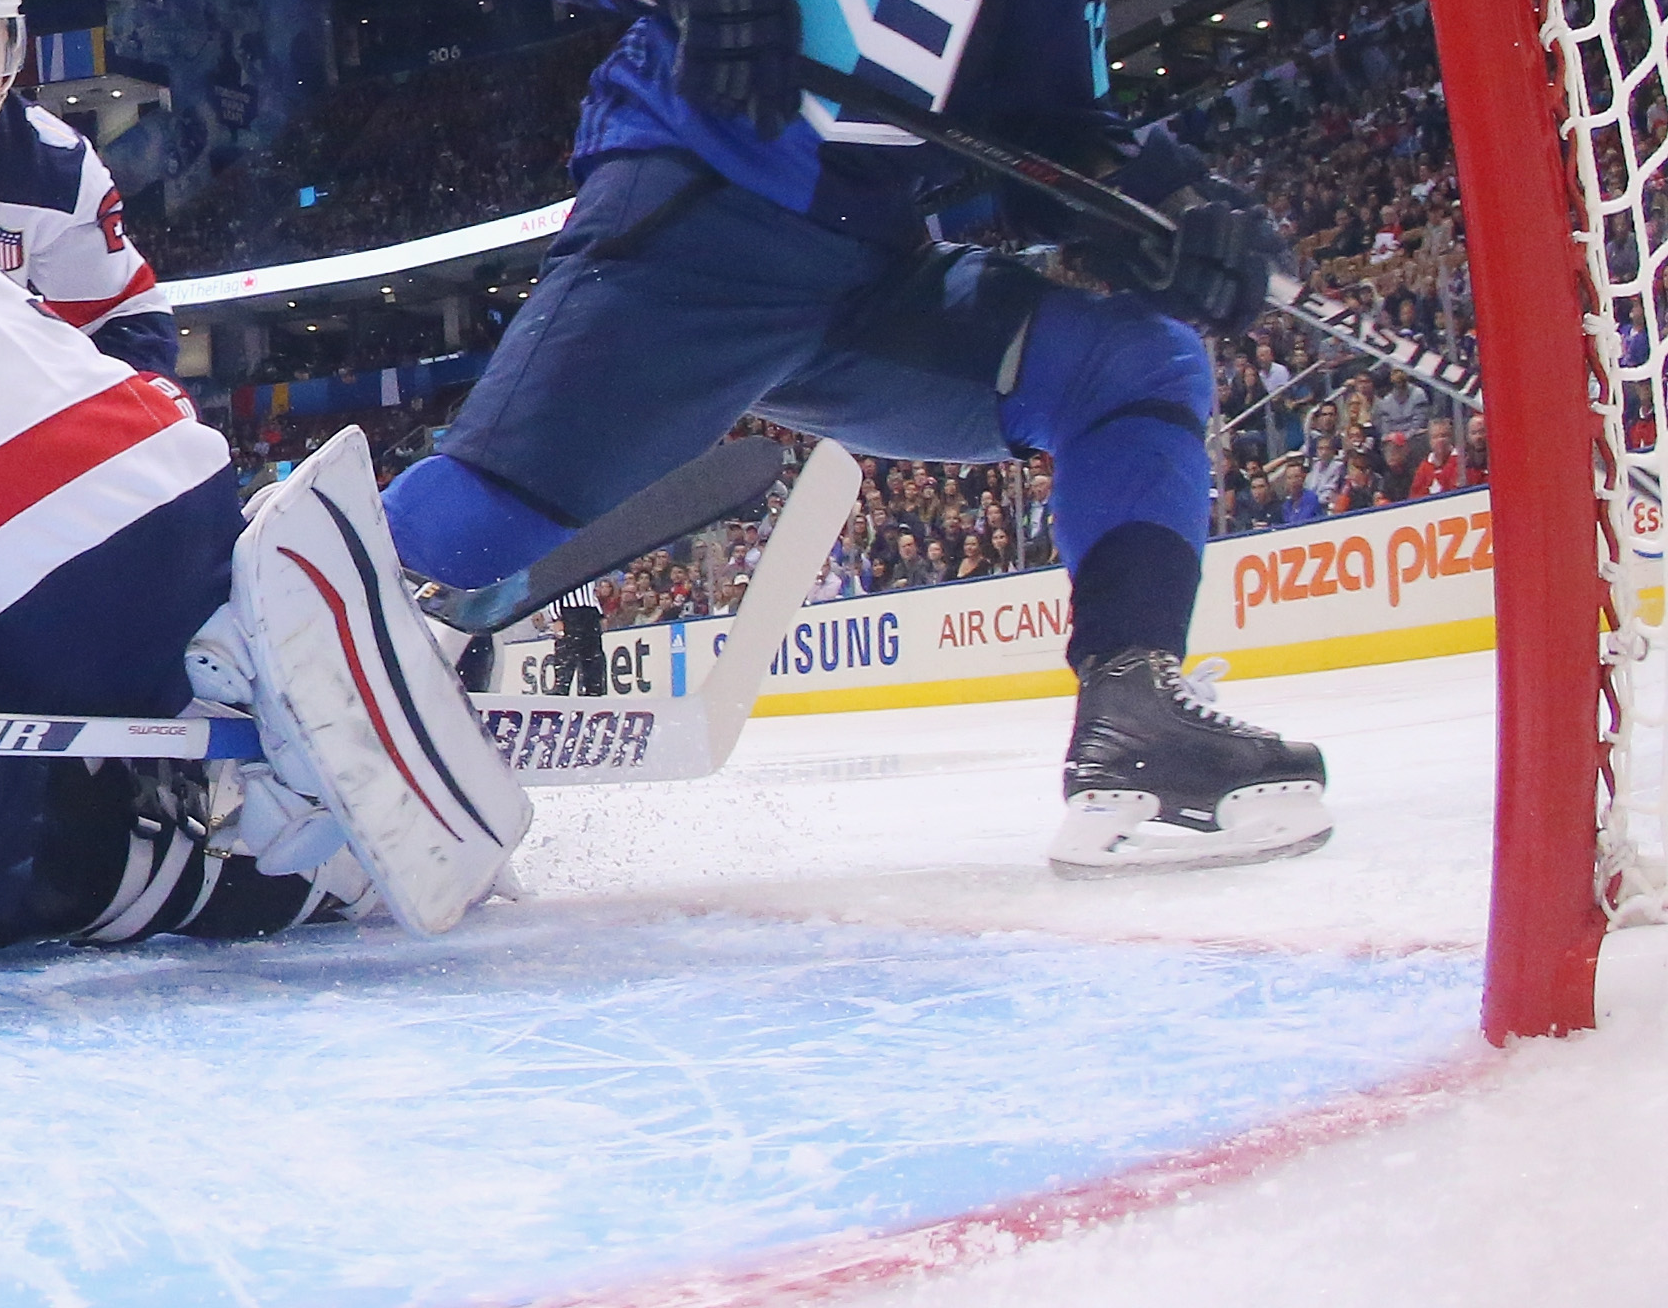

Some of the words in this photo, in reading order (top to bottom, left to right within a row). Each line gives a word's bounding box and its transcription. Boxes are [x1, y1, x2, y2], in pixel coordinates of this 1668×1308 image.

[427, 44, 462, 65] 306
[519, 215, 547, 235] AIR
[1385, 516, 1494, 608] pizz
[714, 612, 899, 676] SSUNG
[938, 610, 986, 649] AIR
[993, 598, 1073, 643] CANA
[521, 638, 651, 696] soet
[479, 709, 656, 771] RRIOR
